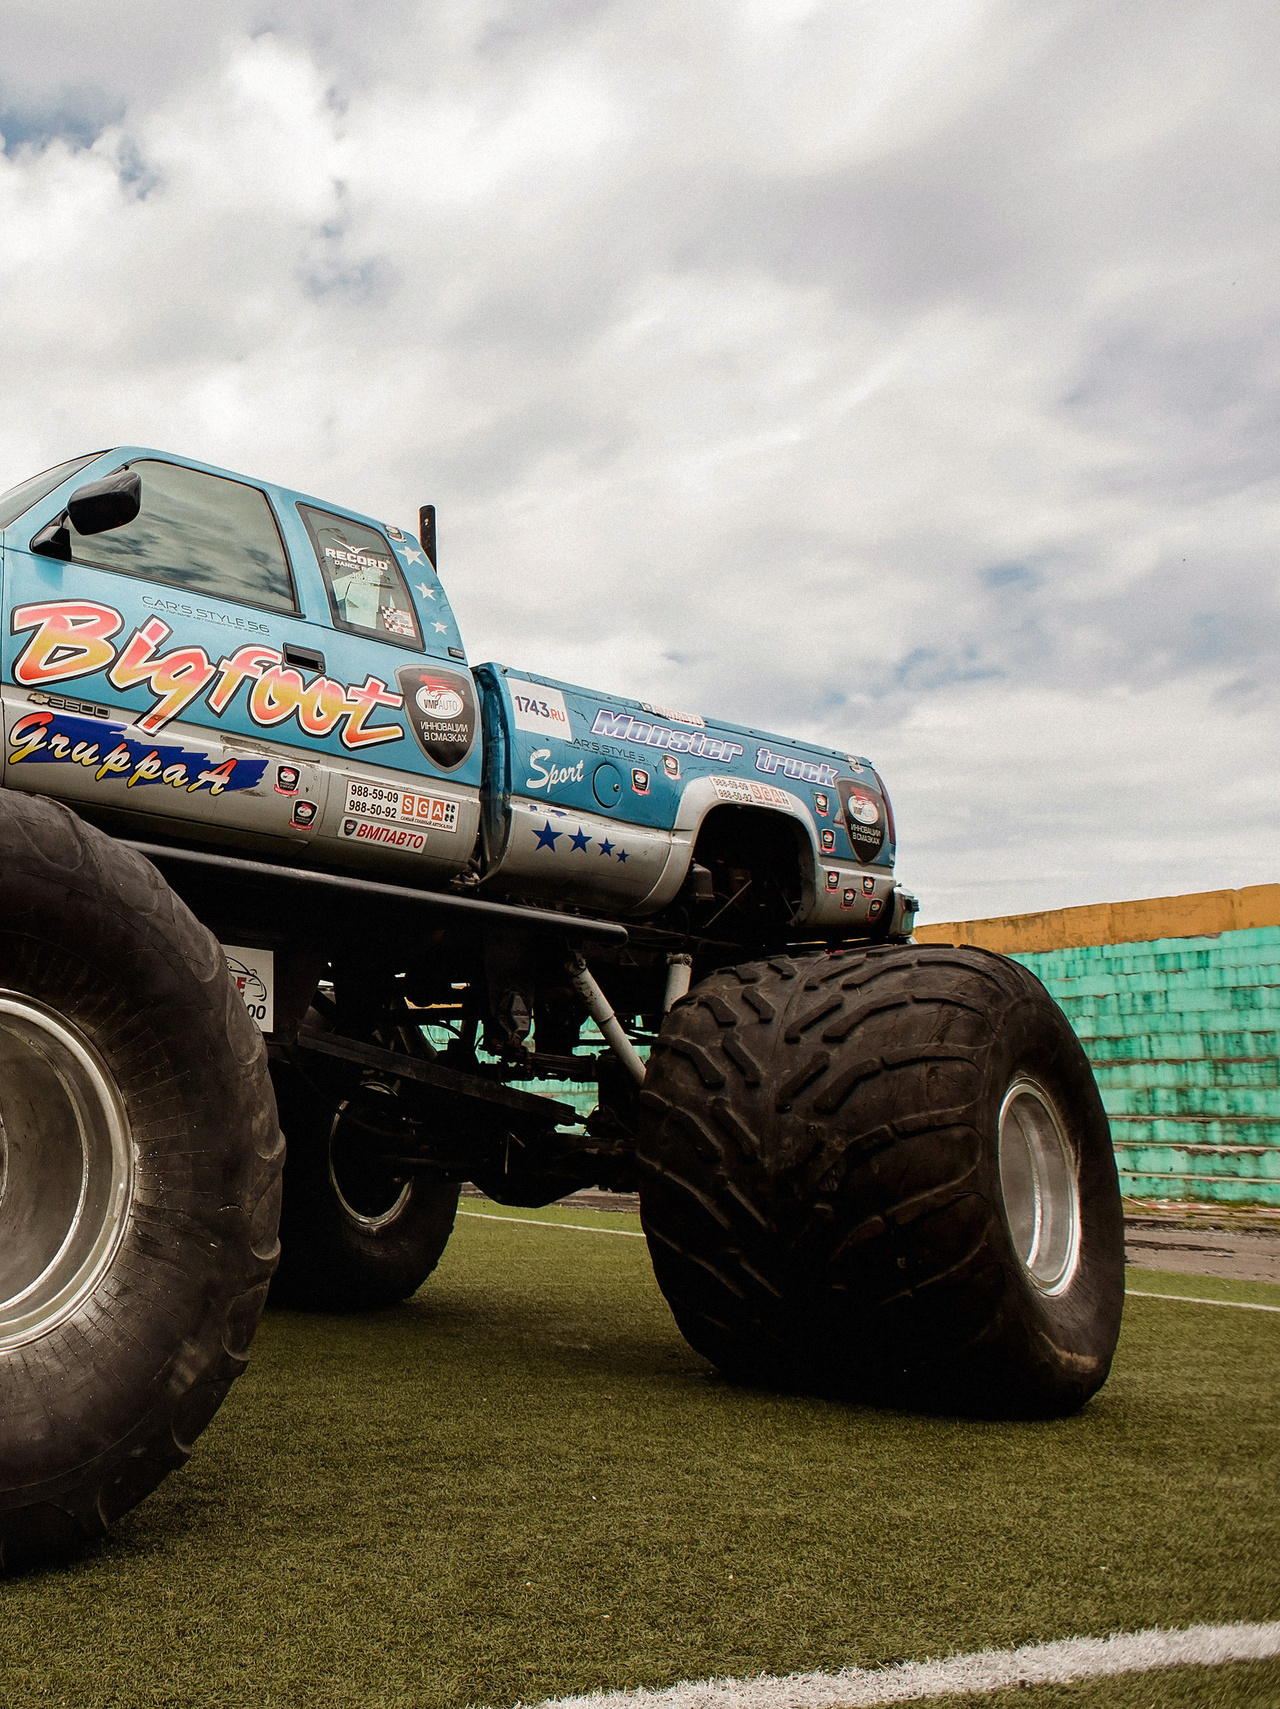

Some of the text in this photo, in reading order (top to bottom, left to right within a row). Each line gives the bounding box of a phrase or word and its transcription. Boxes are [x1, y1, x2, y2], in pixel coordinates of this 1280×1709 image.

[325, 547, 389, 571] RECORD
[334, 560, 360, 571] DANCE
[142, 596, 192, 614] CAR'S
[196, 608, 245, 627] STYLE
[248, 620, 270, 633] 56
[11, 599, 405, 751] Bigfoot
[49, 696, 110, 719] 3500
[420, 721, 468, 733] ИННОВАЦИИ
[424, 732, 468, 743] В СМАЗКАХ
[590, 709, 744, 763] Monster
[755, 747, 839, 788] truck
[602, 744, 636, 760] STYLE
[526, 748, 585, 793] Sport
[351, 784, 399, 804] 988-59-09
[752, 785, 782, 804] SGA
[349, 800, 397, 819] 988-50-92
[403, 796, 443, 820] SGA
[356, 823, 424, 849] ВМПАВТО
